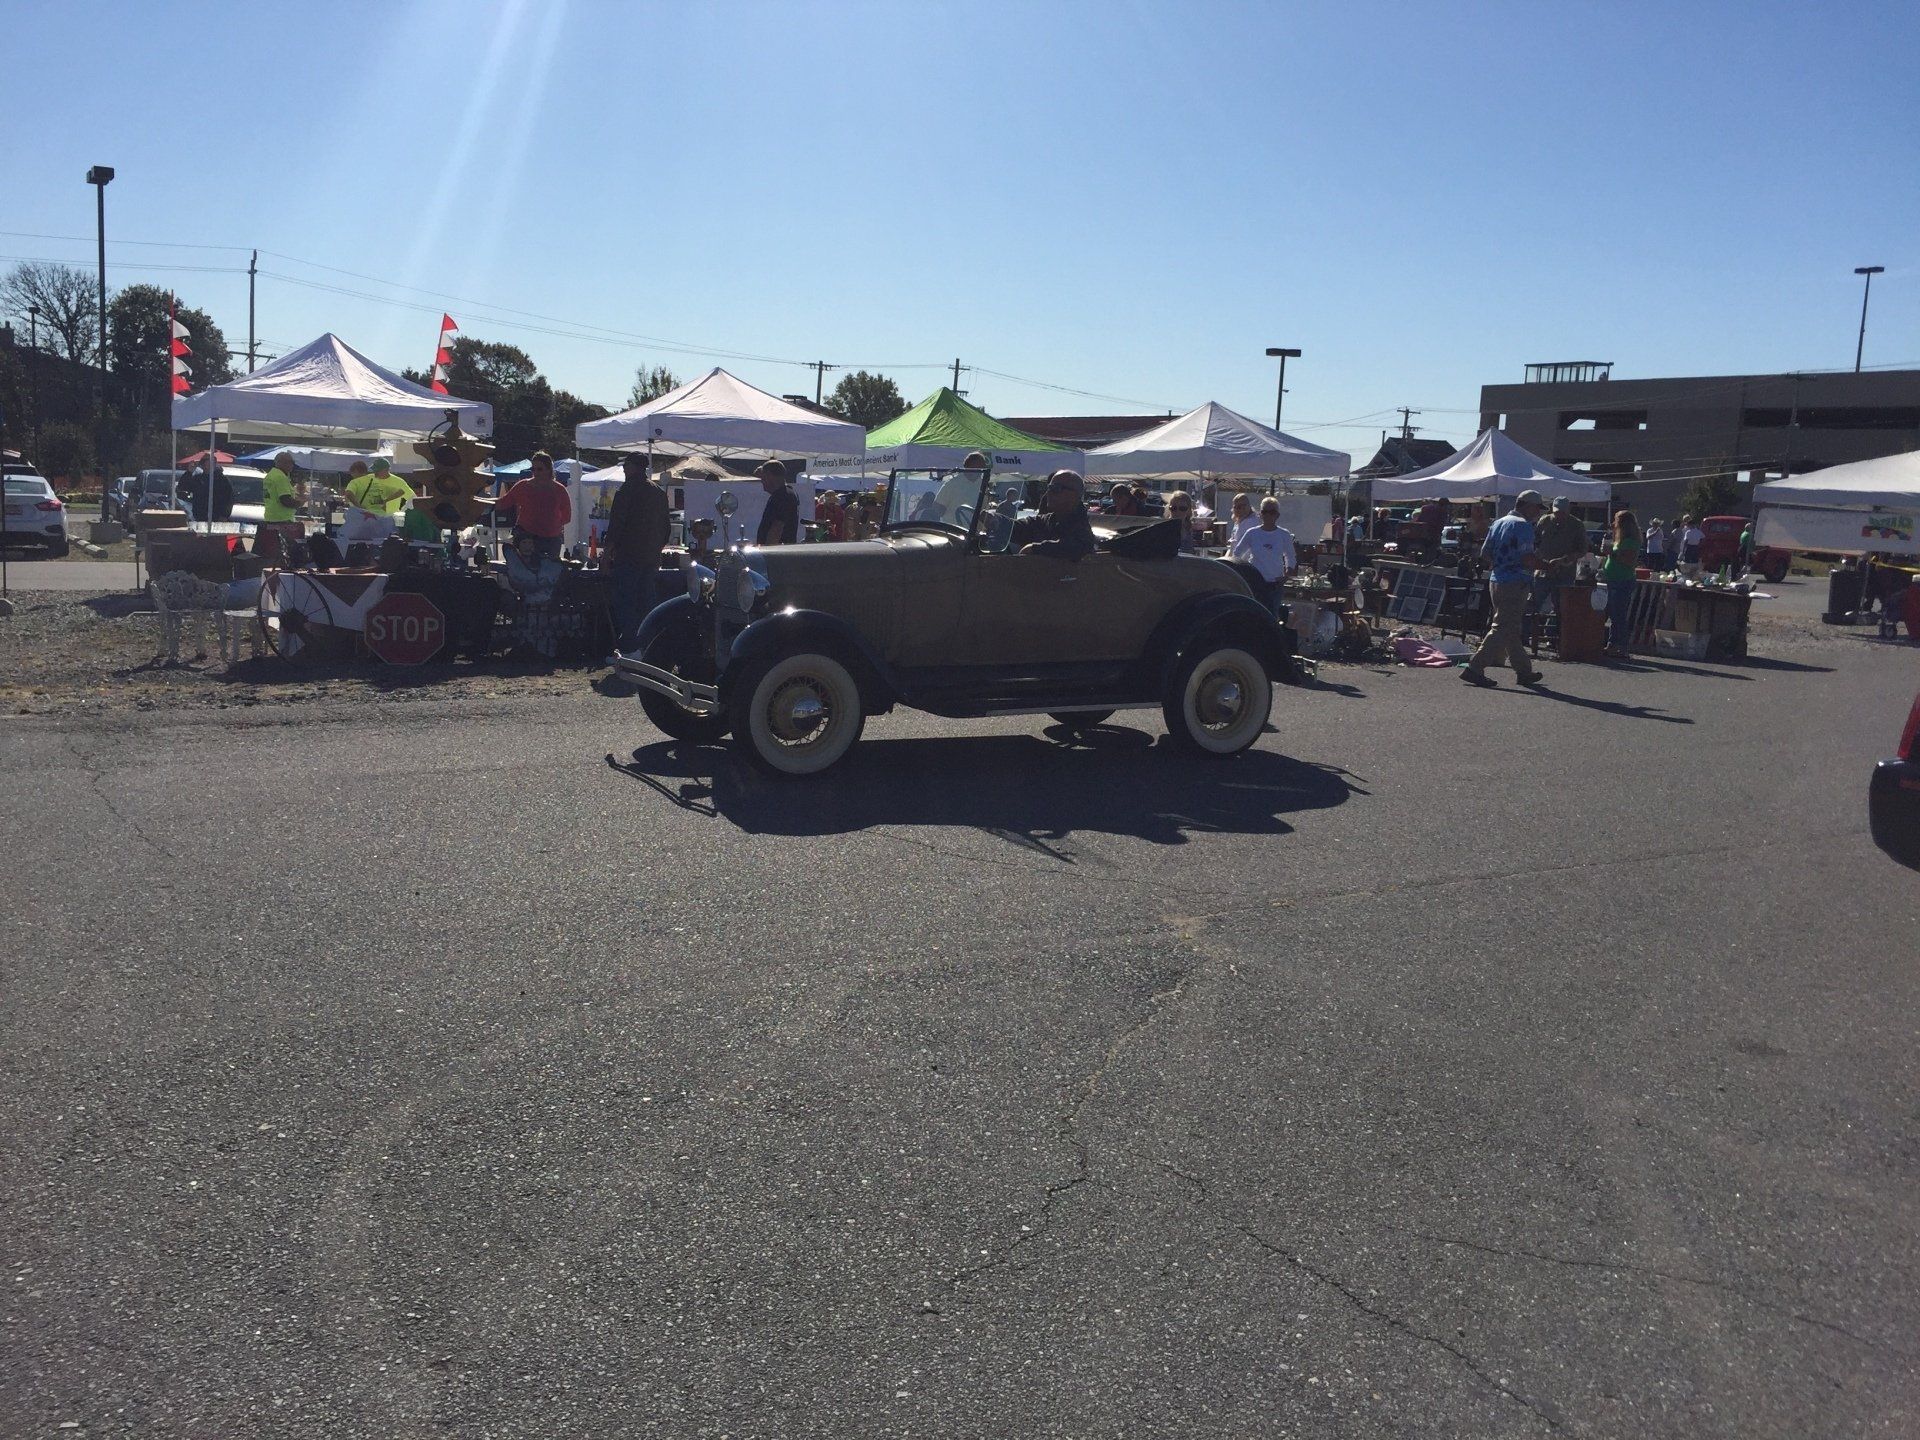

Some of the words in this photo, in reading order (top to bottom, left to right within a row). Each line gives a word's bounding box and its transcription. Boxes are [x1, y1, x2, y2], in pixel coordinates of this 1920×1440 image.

[813, 457, 837, 467] America's
[838, 457, 852, 467] Most
[853, 455, 882, 467] Conenient
[883, 452, 898, 463] Bank
[995, 455, 1022, 465] Bank
[370, 614, 440, 642] STOP
